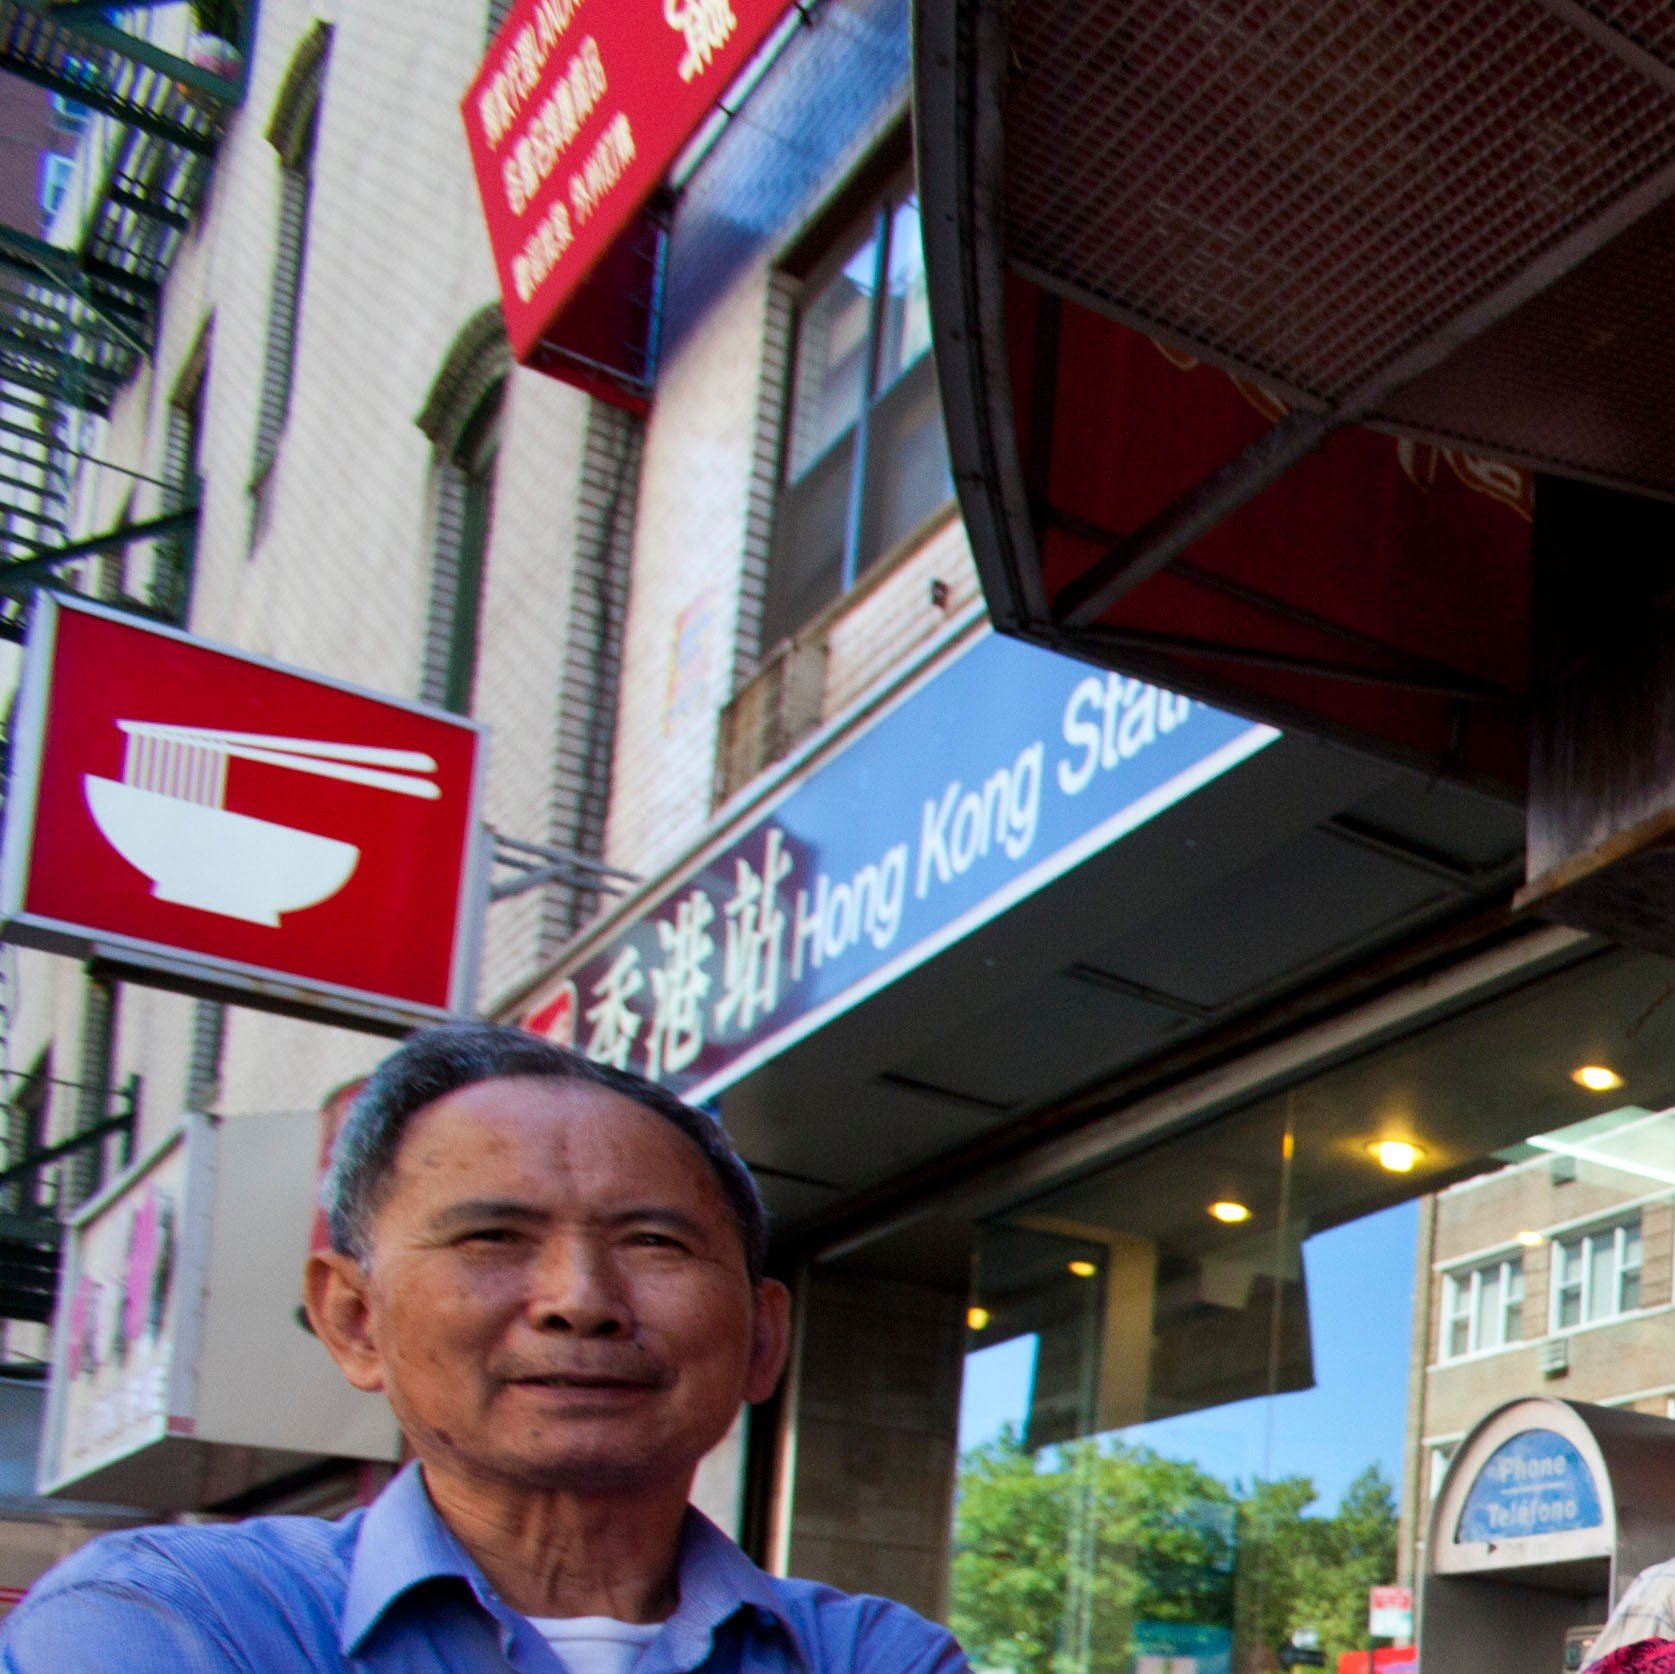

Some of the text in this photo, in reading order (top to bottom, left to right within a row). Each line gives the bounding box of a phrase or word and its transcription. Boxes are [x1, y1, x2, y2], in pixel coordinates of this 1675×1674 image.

[792, 842, 908, 981] Hong
[916, 740, 1044, 900] Kong
[586, 828, 793, 1082] 香港站
[1487, 1498, 1578, 1528] Teléfono
[1497, 1454, 1567, 1482] Phone
